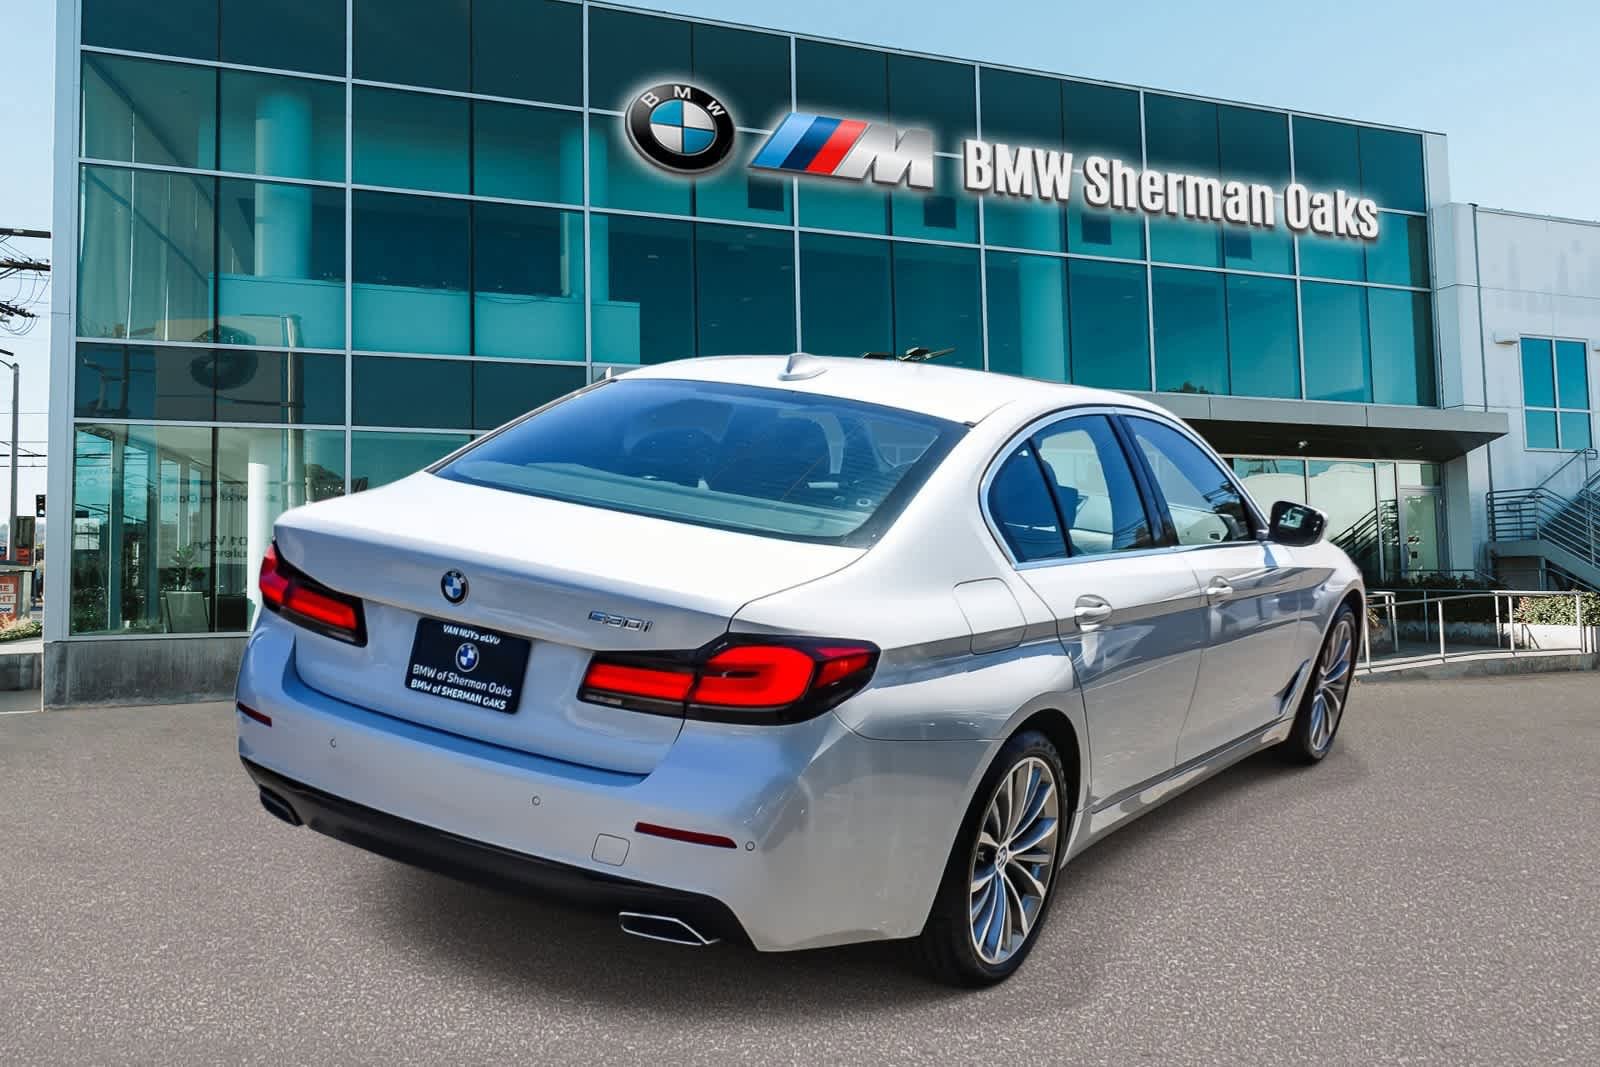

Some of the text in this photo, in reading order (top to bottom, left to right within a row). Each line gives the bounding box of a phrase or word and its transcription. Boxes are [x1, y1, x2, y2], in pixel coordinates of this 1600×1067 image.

[641, 85, 725, 117] BMW
[963, 138, 1379, 241] BMW Sherman Oaks
[443, 624, 459, 635] VAN
[410, 679, 507, 710] BMW of SHERMAN OAKS
[412, 664, 512, 697] BMW of Sherman Oaks
